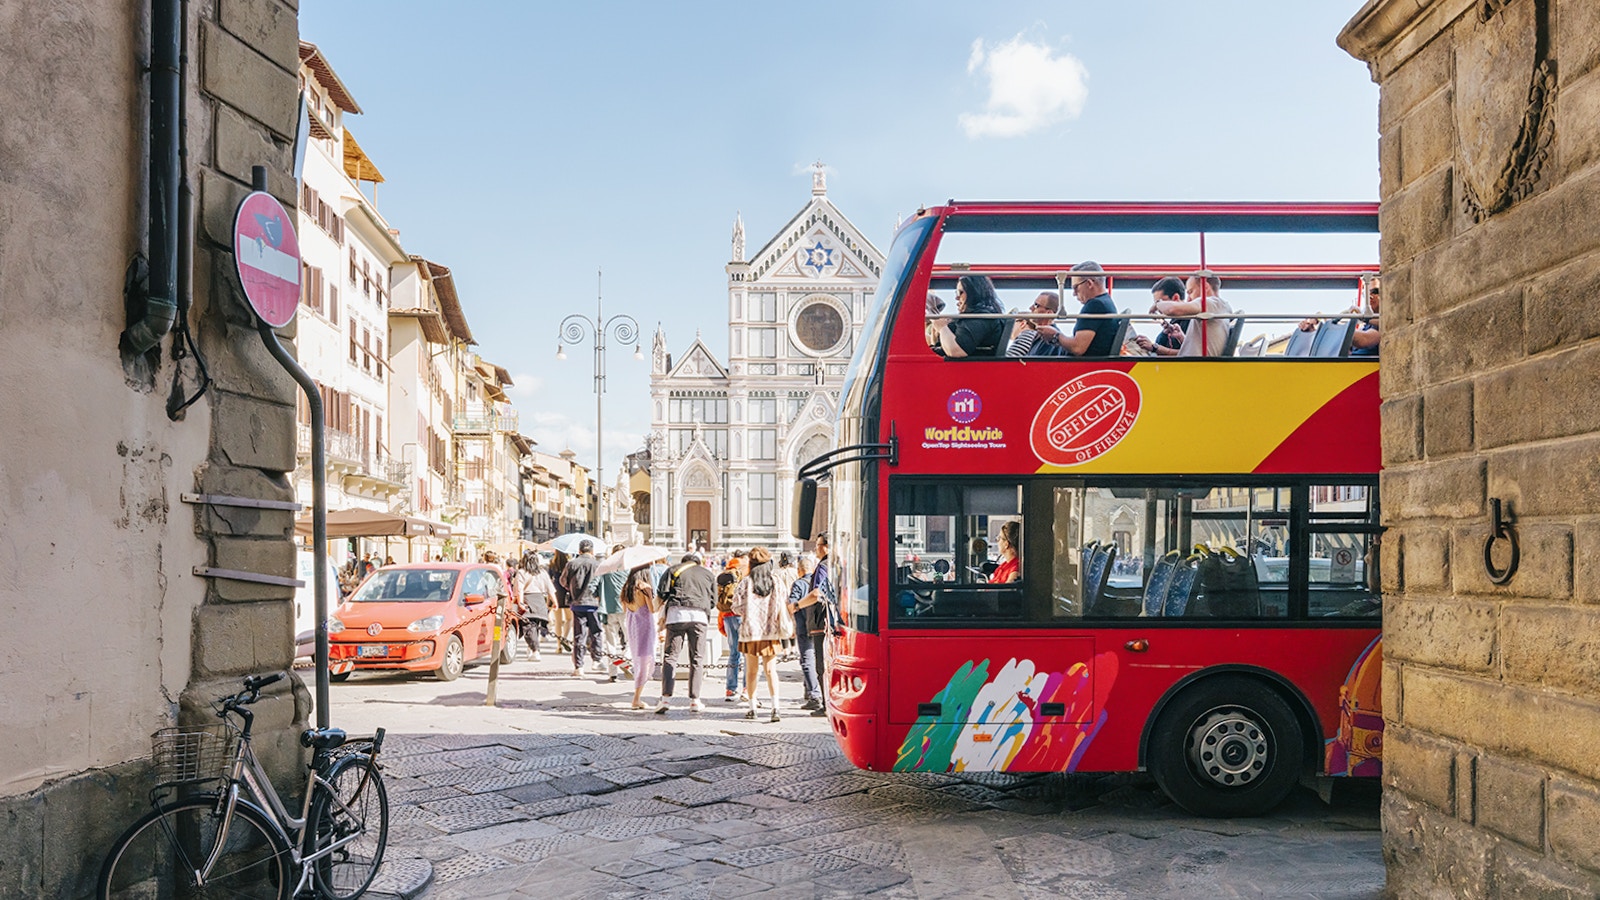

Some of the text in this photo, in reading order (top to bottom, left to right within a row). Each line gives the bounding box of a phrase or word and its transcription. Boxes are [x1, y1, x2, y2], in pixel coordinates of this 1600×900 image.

[1049, 380, 1087, 407] TOUR
[924, 426, 1003, 441] Worldwide
[1052, 392, 1121, 444] OFFICIAL
[1075, 410, 1136, 462] OF FIRENZE
